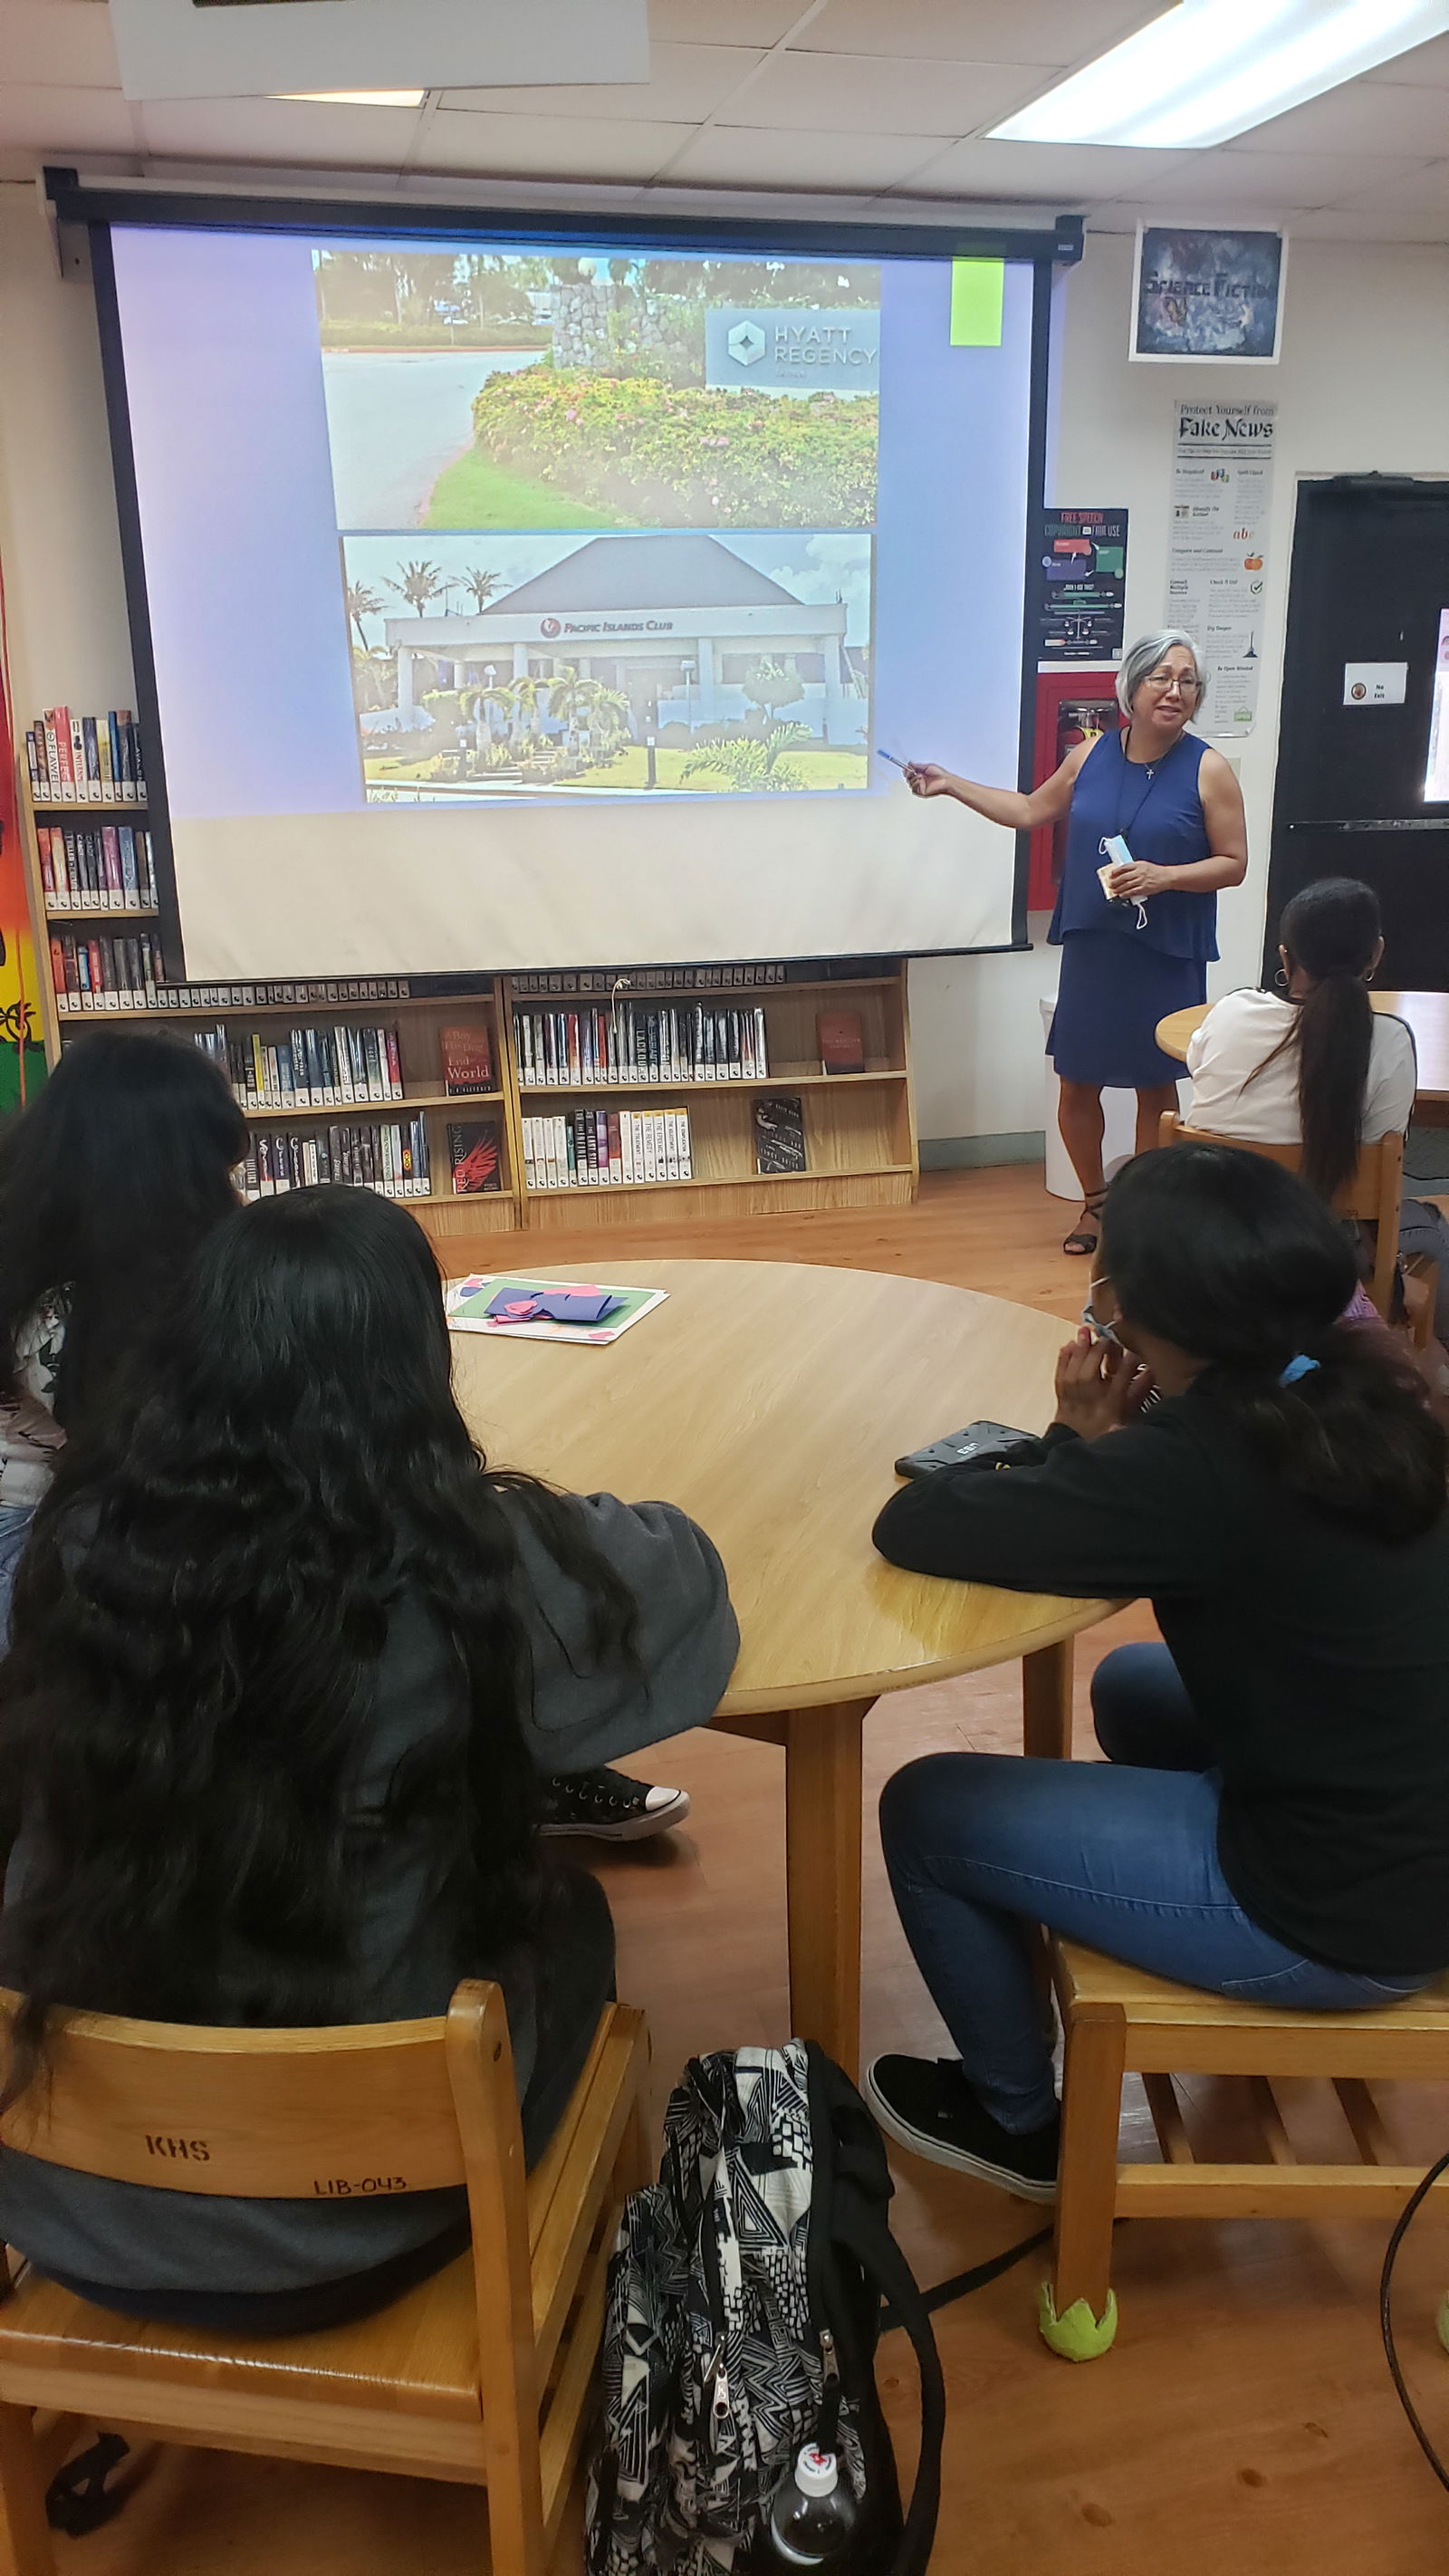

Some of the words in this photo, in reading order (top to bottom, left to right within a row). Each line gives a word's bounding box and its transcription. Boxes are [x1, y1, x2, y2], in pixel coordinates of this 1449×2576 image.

[775, 326, 852, 345] HYATT
[774, 347, 878, 367] REGENCY
[1180, 404, 1213, 415] Protect
[1216, 404, 1251, 416] Yourself
[1252, 405, 1274, 417] from
[1179, 417, 1221, 438] Fake
[1221, 418, 1274, 441] News
[1107, 525, 1120, 537] USE
[563, 622, 600, 634] PACIFIC
[602, 621, 644, 632] ISLANDS
[646, 620, 674, 631] CLUB
[636, 1028, 646, 1068] LACKOU
[448, 1055, 470, 1067] End
[446, 1064, 490, 1080] World
[452, 1125, 466, 1166] RISING
[456, 1168, 469, 1193] RED
[144, 2134, 211, 2161] KHS
[313, 2176, 408, 2196] LIB-043
